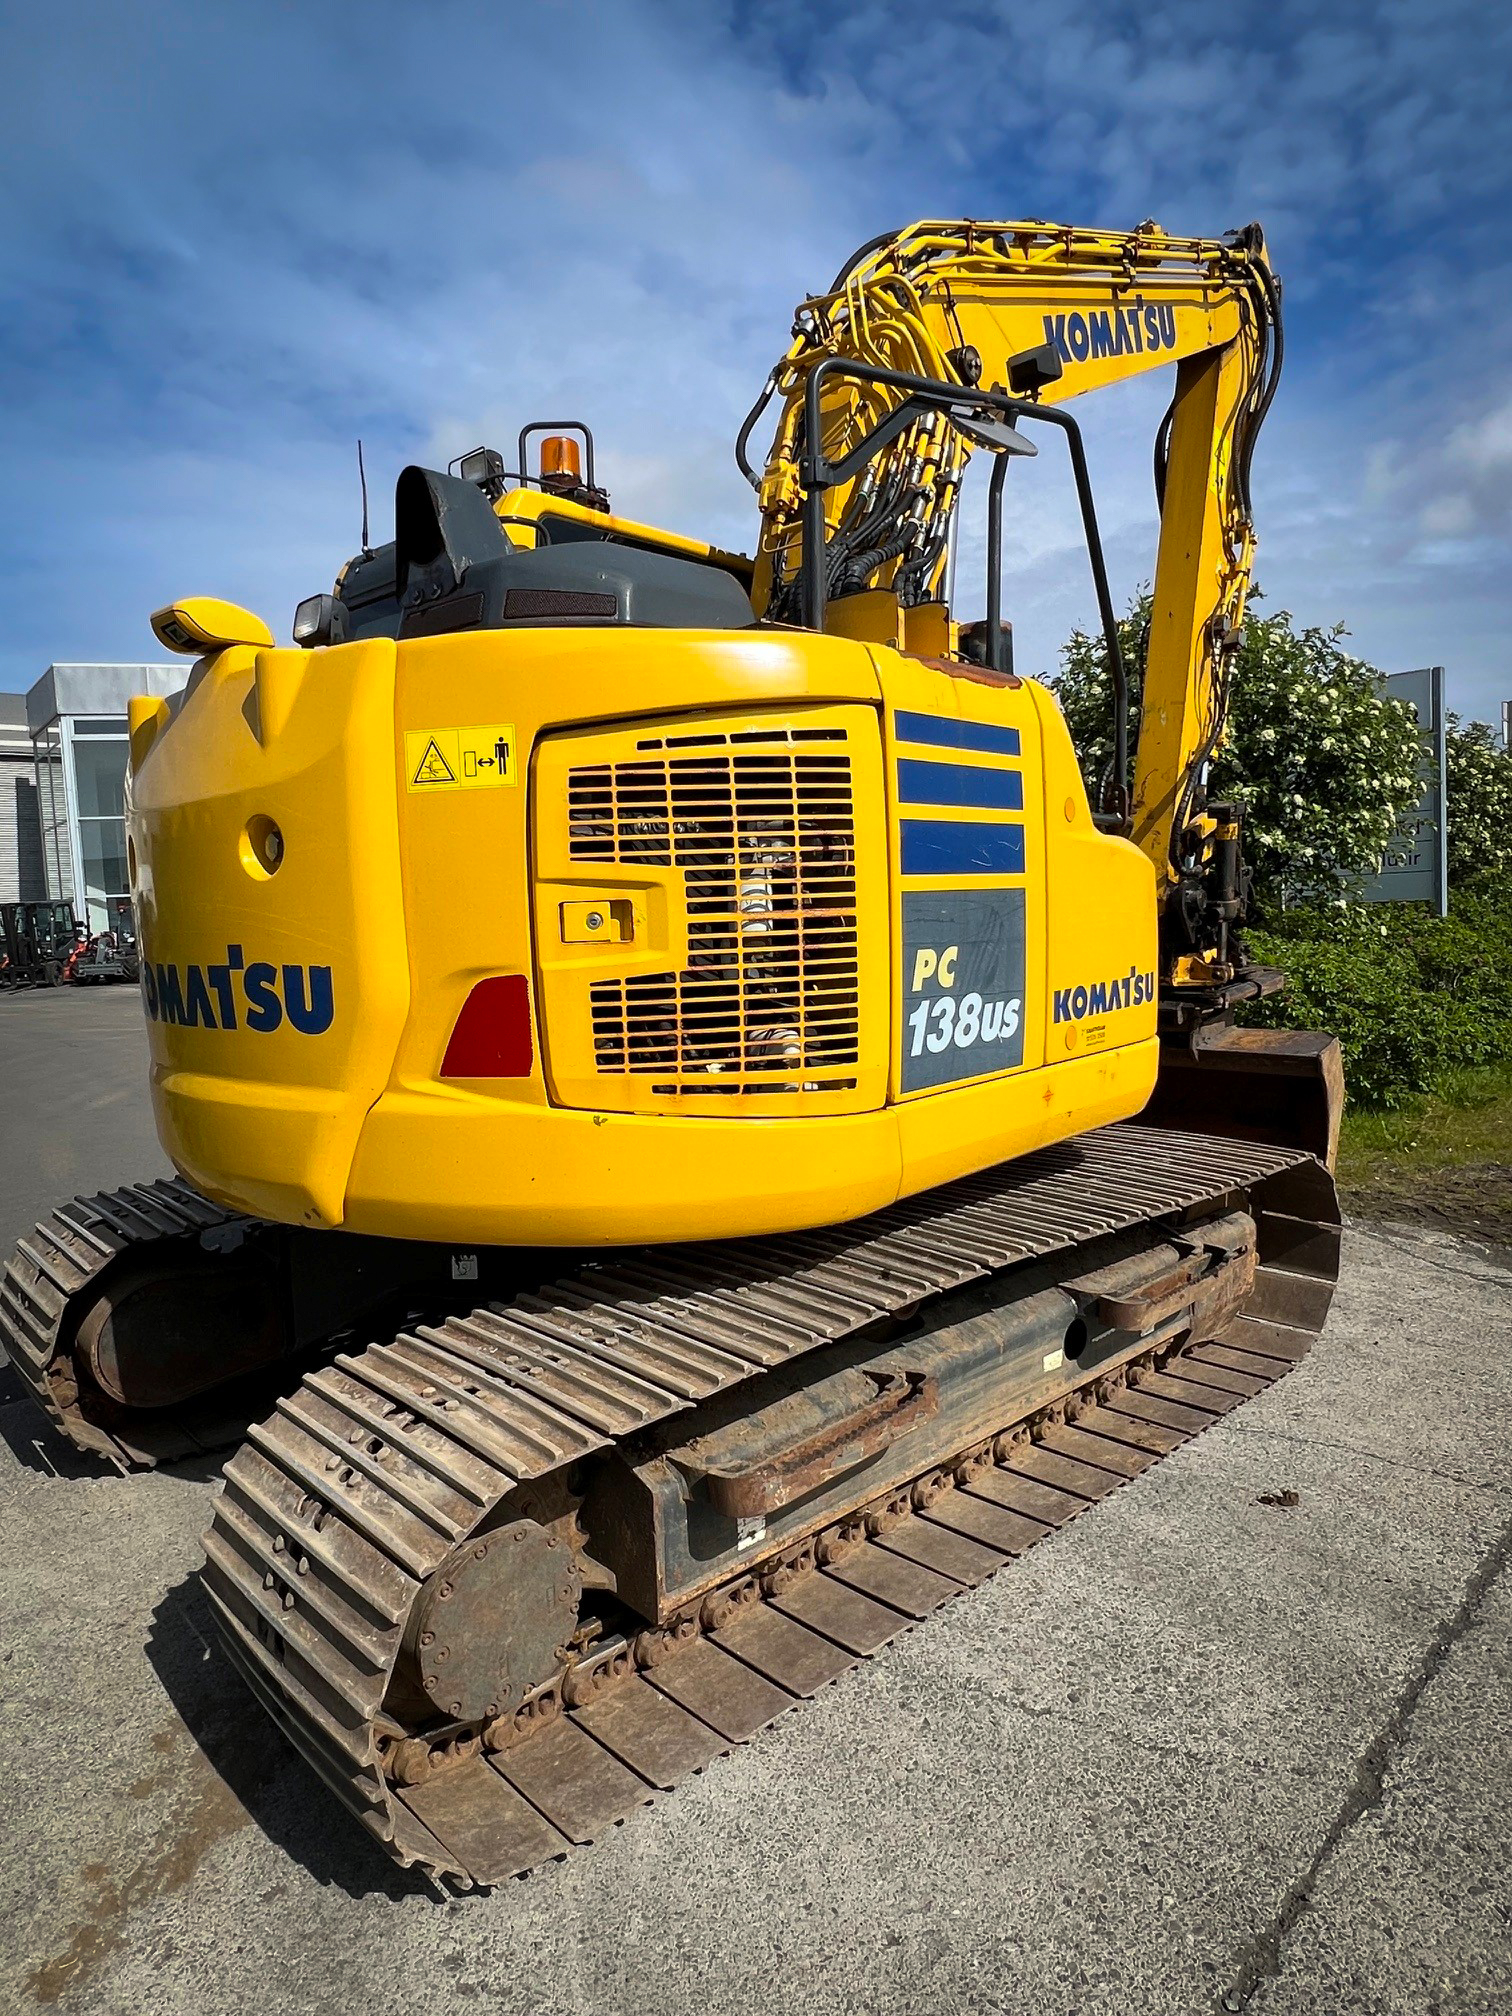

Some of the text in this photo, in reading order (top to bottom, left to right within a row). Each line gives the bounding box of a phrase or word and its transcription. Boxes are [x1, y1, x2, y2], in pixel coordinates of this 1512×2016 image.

[1042, 294, 1176, 363] KOMATSU
[143, 944, 335, 1034] OMATSU
[911, 945, 959, 992] PC
[1053, 965, 1154, 1024] KOMATSU
